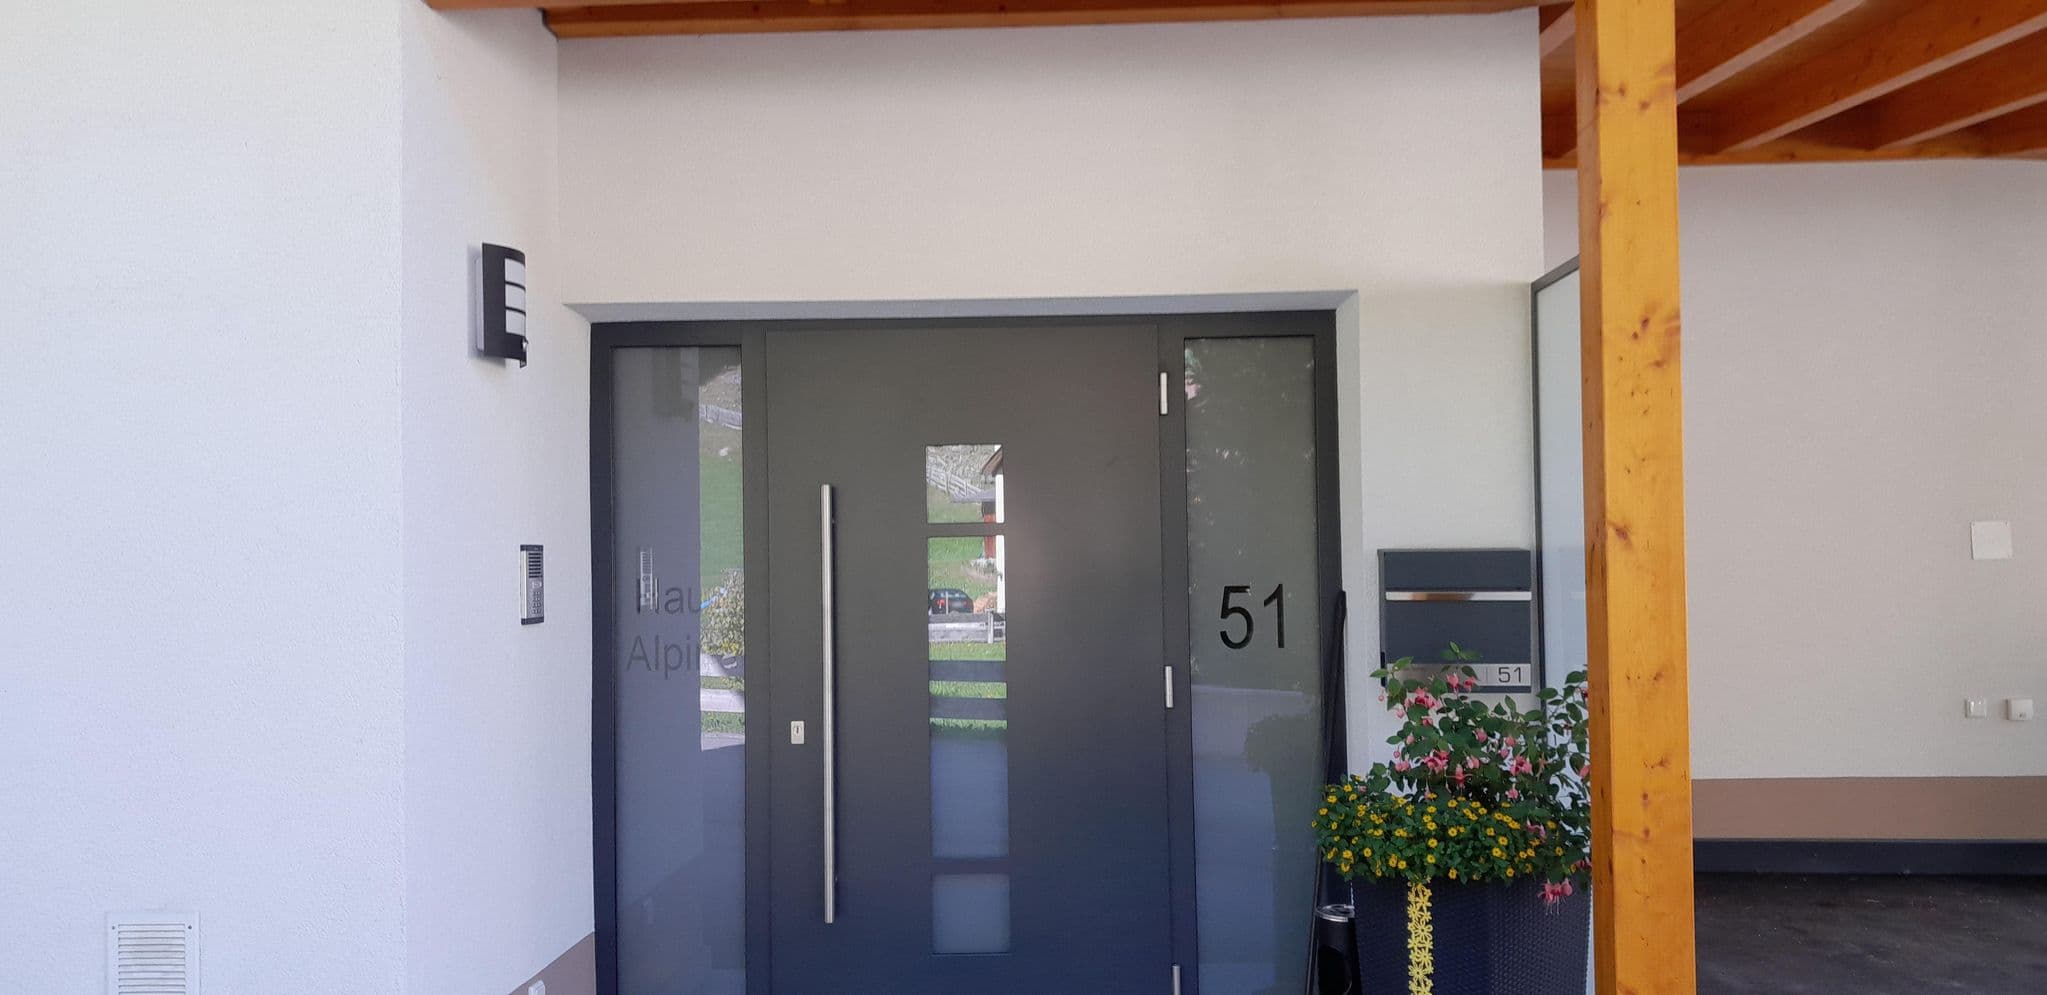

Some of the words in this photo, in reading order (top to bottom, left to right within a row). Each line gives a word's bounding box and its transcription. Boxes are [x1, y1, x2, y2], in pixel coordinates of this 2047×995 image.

[635, 578, 704, 615] Hau
[1220, 584, 1285, 649] 51
[1498, 666, 1522, 683] 51
